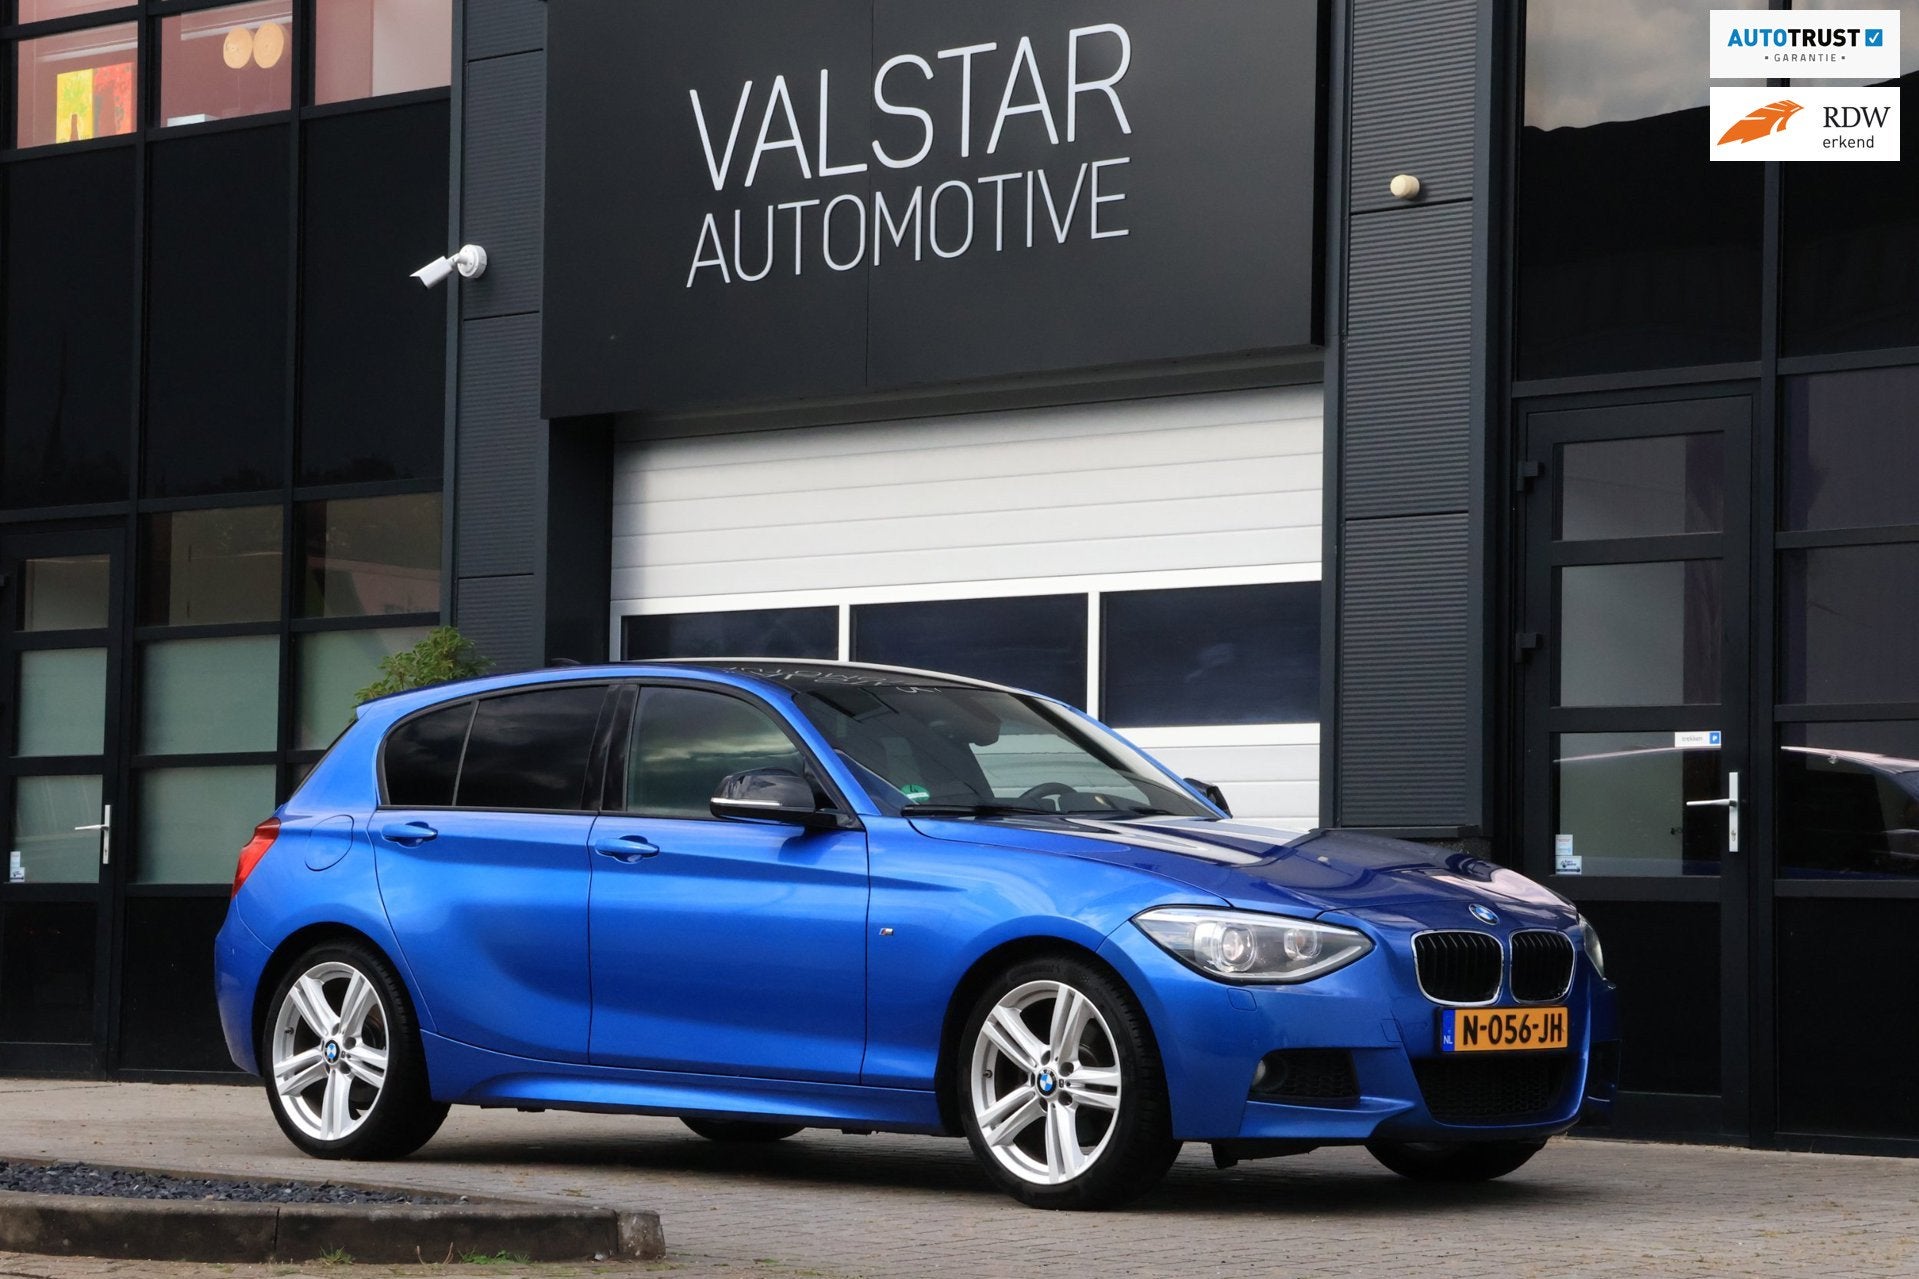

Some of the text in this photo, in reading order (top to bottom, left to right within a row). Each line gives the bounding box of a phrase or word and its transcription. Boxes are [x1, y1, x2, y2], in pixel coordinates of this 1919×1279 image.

[690, 23, 1132, 191] VALSTAR
[686, 157, 1131, 288] AUTOMOTIVE
[1443, 1035, 1453, 1045] NL
[1462, 1013, 1563, 1046] N-056-JH
